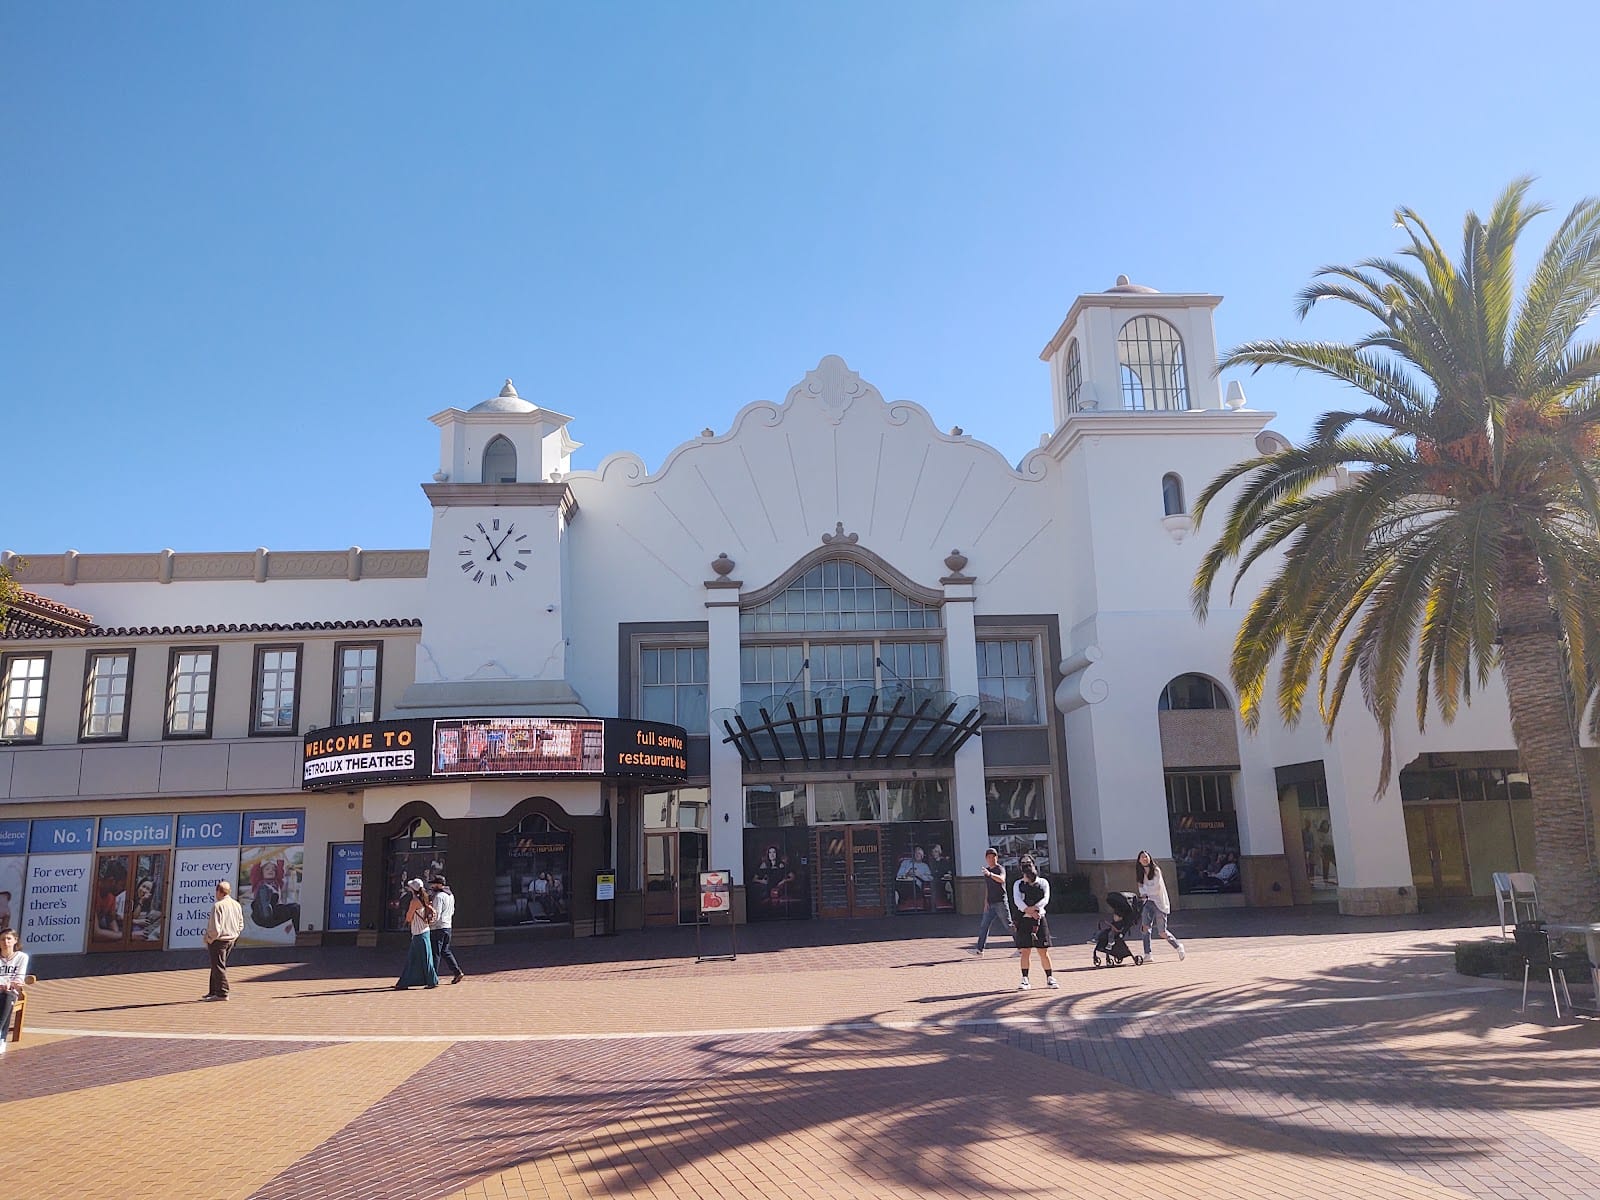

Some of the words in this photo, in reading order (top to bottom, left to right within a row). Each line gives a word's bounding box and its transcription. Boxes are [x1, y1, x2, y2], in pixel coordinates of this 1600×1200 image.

[306, 734, 373, 757] WELCOME
[383, 730, 413, 747] TO
[636, 730, 655, 746] full
[657, 735, 683, 750] service
[345, 754, 414, 771] THEATRES
[619, 751, 674, 768] restaurant
[0, 830, 25, 840] idence
[53, 828, 80, 844] No.
[85, 827, 92, 843] 1
[103, 825, 169, 844] hospital
[181, 824, 196, 839] in
[200, 823, 223, 839] OC
[32, 867, 52, 878] For
[54, 867, 86, 879] every
[181, 861, 199, 873] For
[202, 862, 233, 874] every
[31, 883, 79, 894] moment
[179, 878, 224, 888] momen
[30, 898, 67, 910] there's
[179, 893, 215, 905] there's
[27, 918, 34, 926] a
[37, 914, 80, 926] Mission
[176, 912, 183, 921] a
[186, 909, 211, 920] Miss
[26, 932, 65, 943] doctor.
[175, 926, 207, 937] docto
